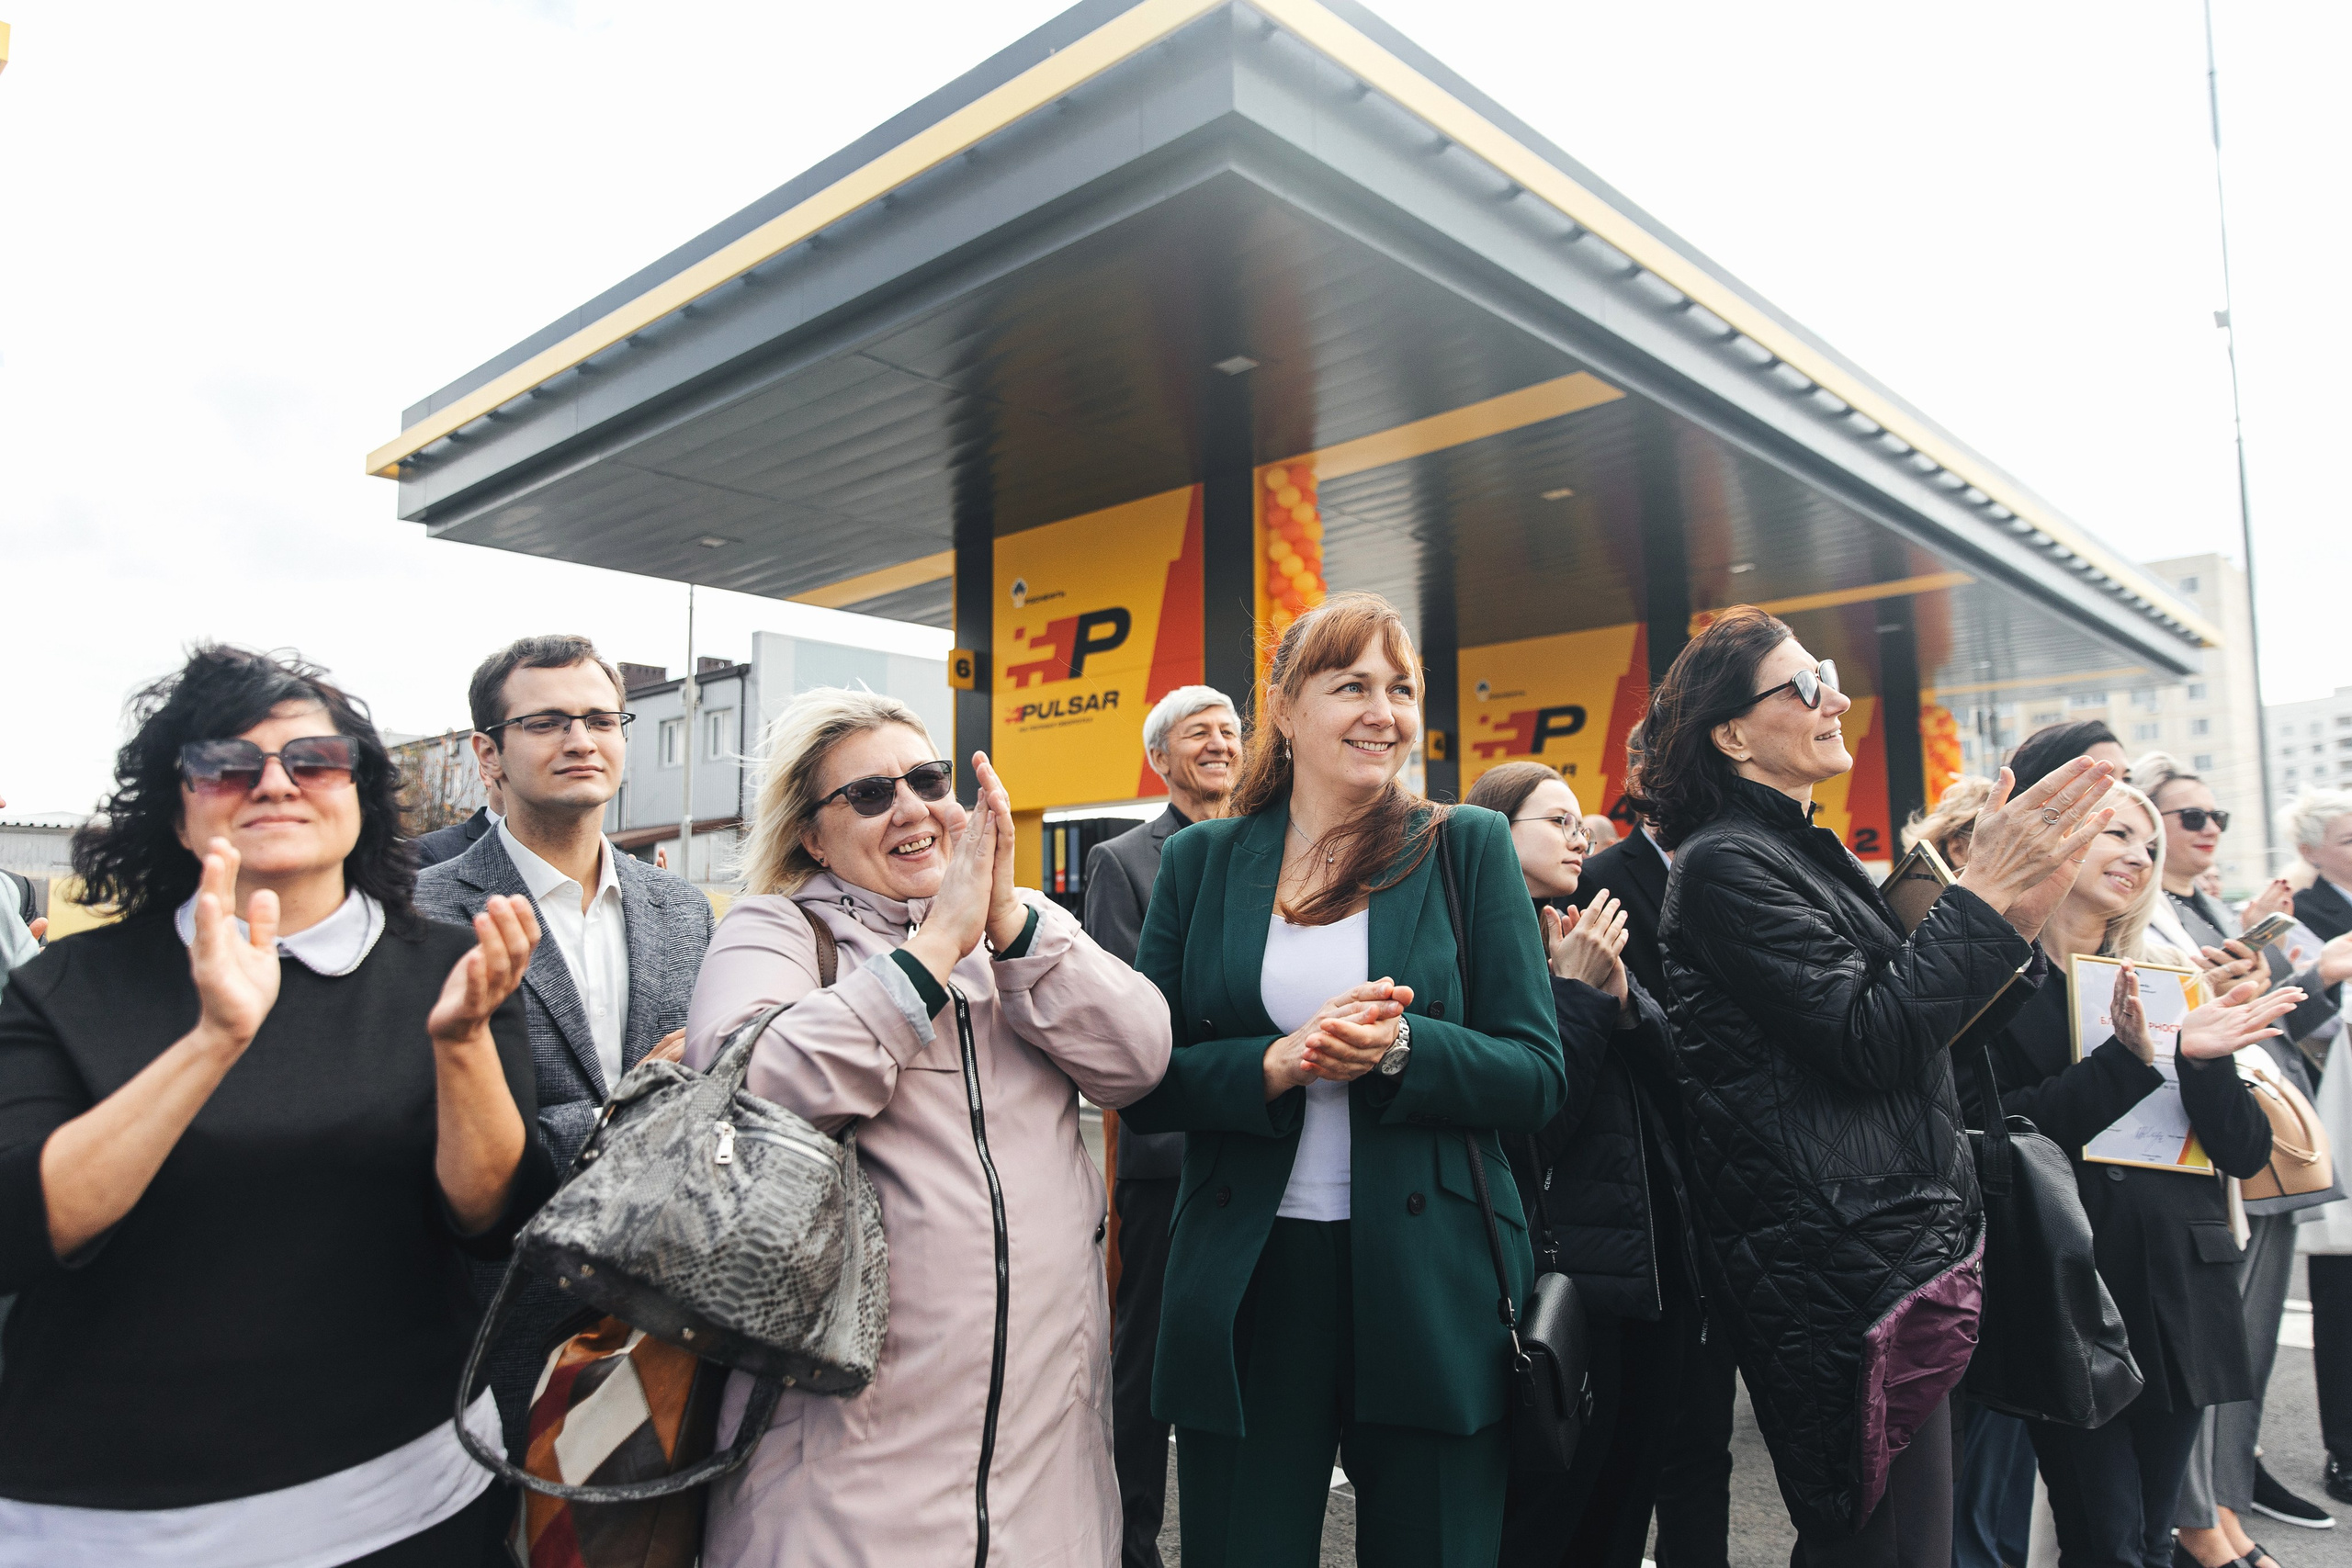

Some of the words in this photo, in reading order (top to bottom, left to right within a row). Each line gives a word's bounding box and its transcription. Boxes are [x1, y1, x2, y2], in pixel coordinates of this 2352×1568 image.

[956, 658, 971, 678] 6
[1021, 689, 1120, 722] PULSAR
[1854, 828, 1881, 852] 2
